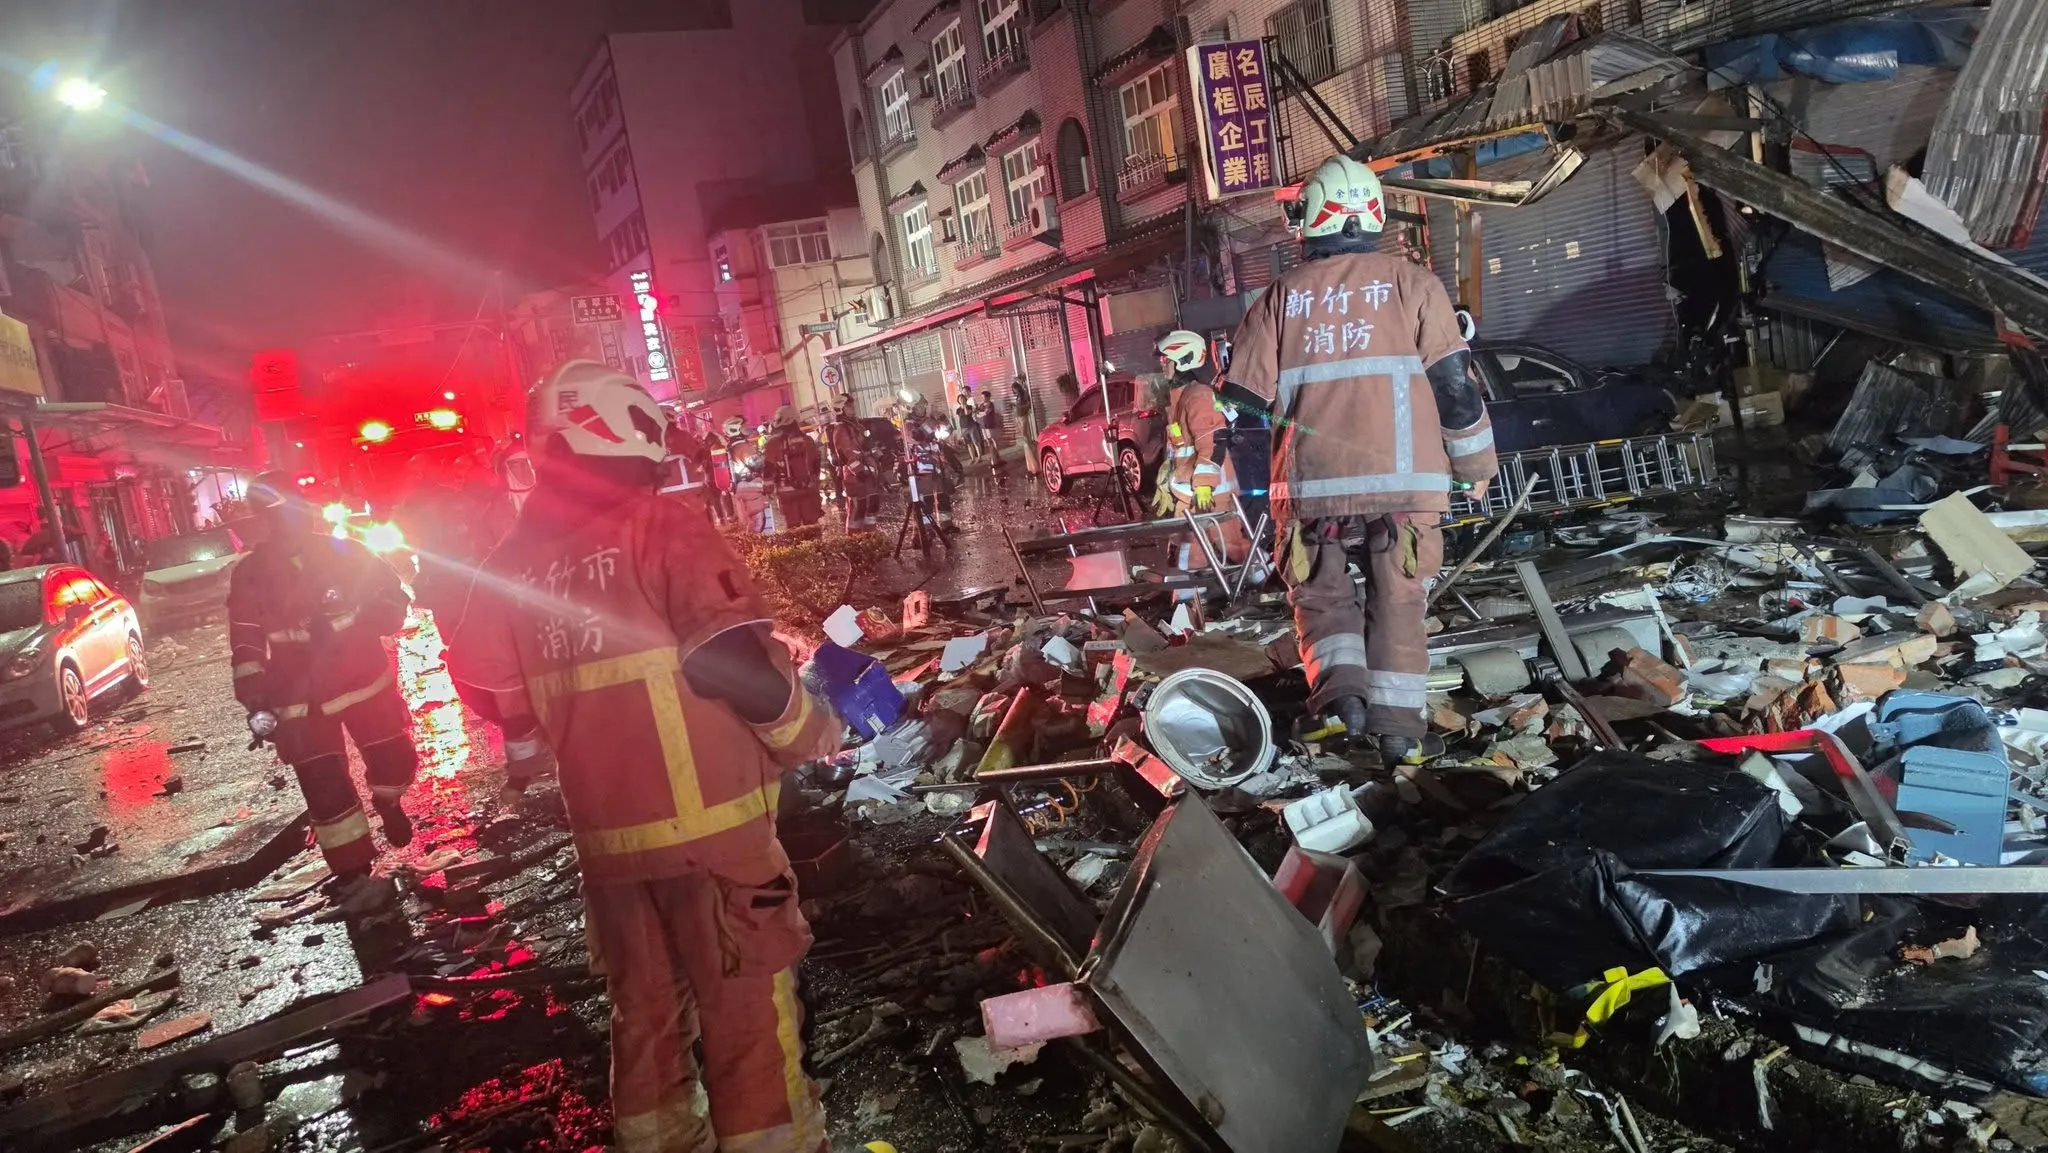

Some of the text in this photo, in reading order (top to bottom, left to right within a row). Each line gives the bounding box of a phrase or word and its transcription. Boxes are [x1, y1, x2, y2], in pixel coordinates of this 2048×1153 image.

[1207, 50, 1249, 187] 廣桓企業
[1235, 48, 1270, 182] 名辰工程
[1285, 279, 1393, 320] 新竹市
[1303, 319, 1375, 354] 消防
